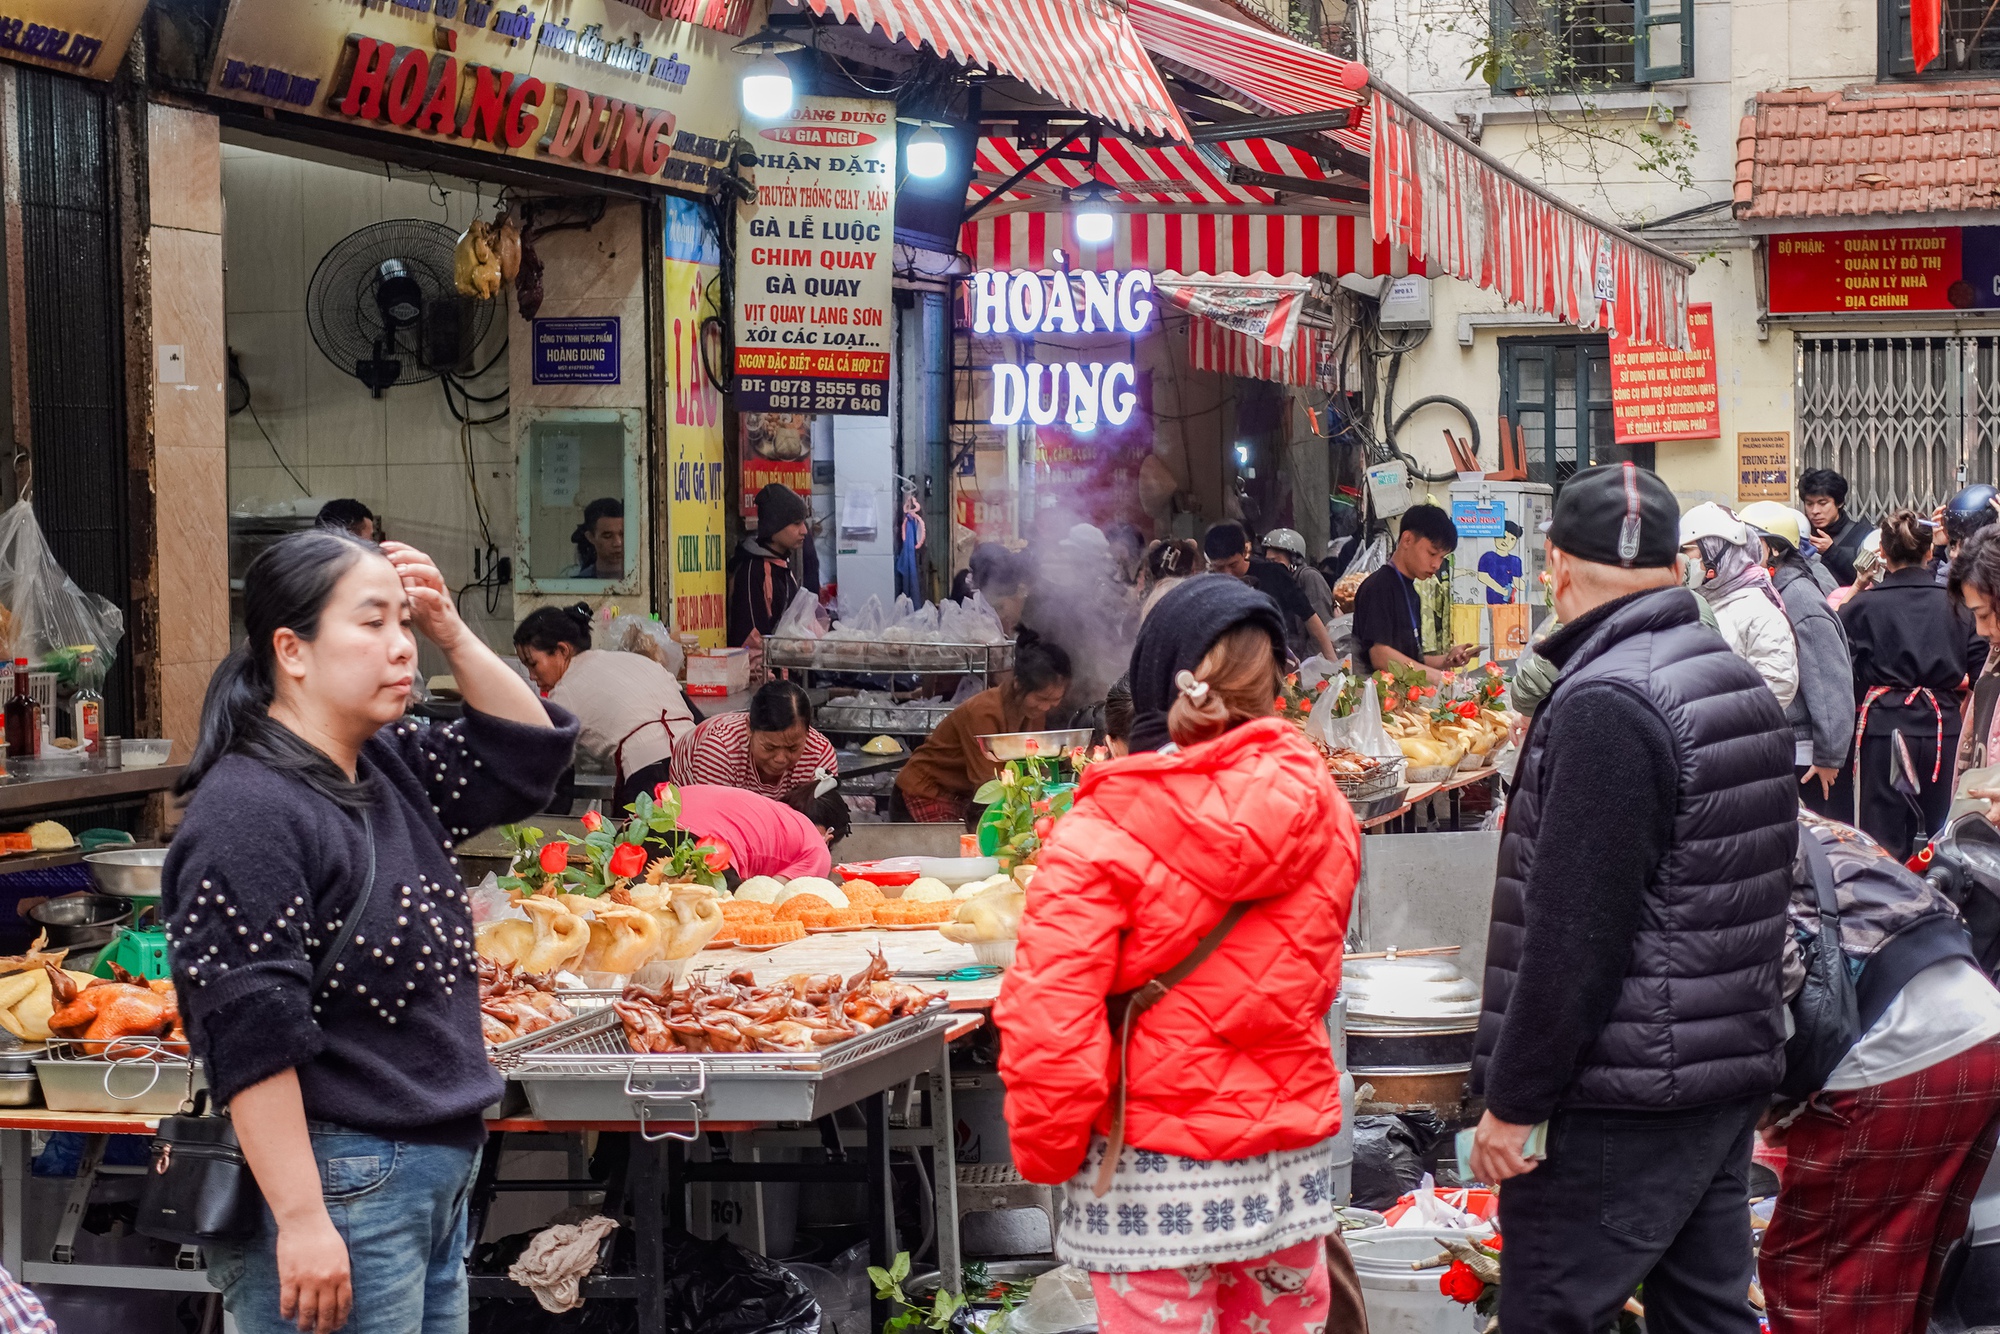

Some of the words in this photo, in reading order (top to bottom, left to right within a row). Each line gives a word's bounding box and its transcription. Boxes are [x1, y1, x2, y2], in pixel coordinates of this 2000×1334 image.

[494, 4, 535, 47] một
[537, 18, 577, 54] món
[577, 23, 606, 62] đến
[606, 32, 651, 74] nhiều
[650, 52, 691, 85] mâm
[341, 30, 546, 148] HOÀNG
[549, 87, 676, 175] DUNG
[784, 106, 836, 121] OÀNG
[840, 111, 887, 123] DUNG
[773, 129, 792, 141] 14
[795, 130, 822, 143] GIA
[826, 131, 860, 144] NGƯ
[757, 151, 821, 174] NHẬN
[829, 154, 886, 176] ĐẶT:
[799, 178, 832, 208] THỐNG
[834, 190, 860, 210] CHAY
[867, 185, 889, 217] MẶN
[750, 216, 781, 238] GÀ
[788, 214, 814, 239] LỄ
[823, 220, 881, 245] LUỘC
[1778, 239, 1791, 256] BỘ
[1794, 239, 1825, 256] PHẬN:
[1844, 235, 1879, 253] QUẢN
[1882, 236, 1897, 251] LÝ
[751, 247, 812, 267] CHIM
[820, 250, 877, 270] QUAY
[1844, 253, 1879, 271] QUẢN
[1882, 254, 1897, 270] LÝ
[1901, 254, 1918, 270] ĐÔ
[1921, 257, 1942, 271] THỊ
[766, 273, 797, 295] GÀ
[804, 278, 862, 298] QUAY
[1845, 272, 1880, 290] QUẢN
[1882, 273, 1897, 288] LÝ
[1901, 273, 1928, 288] NHÀ
[973, 248, 1153, 334] HOÀNG
[1845, 295, 1867, 309] ĐỊA
[1869, 292, 1909, 307] CHÍNH
[744, 304, 766, 325] VỊT
[770, 305, 806, 324] QUAY
[810, 306, 848, 328] LẠNG
[852, 307, 883, 327] SƠN
[539, 333, 555, 343] CÔNG
[556, 334, 564, 343] TY
[564, 334, 580, 343] TNHH
[580, 334, 595, 344] THỰC
[745, 326, 777, 343] XÔI
[782, 327, 818, 344] CÁC
[822, 332, 880, 350] LOẠI...
[546, 346, 579, 362] HOÀNG
[580, 348, 605, 361] DUNG
[674, 270, 718, 428] LẨU
[1613, 352, 1626, 366] CÁC
[1627, 353, 1639, 366] QUY
[1640, 352, 1655, 366] ĐỊNH
[1656, 351, 1669, 363] CỦA
[738, 354, 767, 369] NGON
[767, 352, 787, 373] ĐẶC
[789, 352, 811, 374] BIỆT
[817, 353, 835, 372] GIÁ
[851, 356, 871, 377] HỢP
[872, 355, 885, 374] LÝ
[1620, 367, 1629, 382] SỬ
[1630, 371, 1647, 384] DỤNG
[1670, 366, 1681, 382] VẬT
[1682, 365, 1695, 381] LIỆU
[741, 379, 766, 392] ĐT:
[770, 380, 811, 394] 0978
[815, 381, 856, 396] 5555
[860, 383, 882, 397] 66
[990, 362, 1137, 426] DUNG
[1613, 387, 1631, 400] CÔNG
[1631, 388, 1640, 401] CỤ
[1663, 382, 1672, 397] SỐ
[769, 394, 811, 408] 0912
[815, 396, 846, 410] 287
[850, 398, 881, 411] 640
[1615, 404, 1624, 418] VÀ
[1625, 404, 1640, 419] NGHỊ
[1641, 404, 1656, 420] ĐỊNH
[1656, 400, 1665, 415] SỐ
[1635, 419, 1652, 435] QUẢN
[1672, 419, 1690, 434] DỤNG
[1690, 416, 1707, 431] PHÁO
[1741, 455, 1768, 466] TRUNG
[1769, 452, 1786, 465] TÂM
[674, 444, 691, 504] LẨU
[693, 452, 707, 505] GÀ,
[708, 462, 722, 509] VỊT
[677, 534, 702, 578] CHIM,
[705, 516, 722, 571] ẾCH
